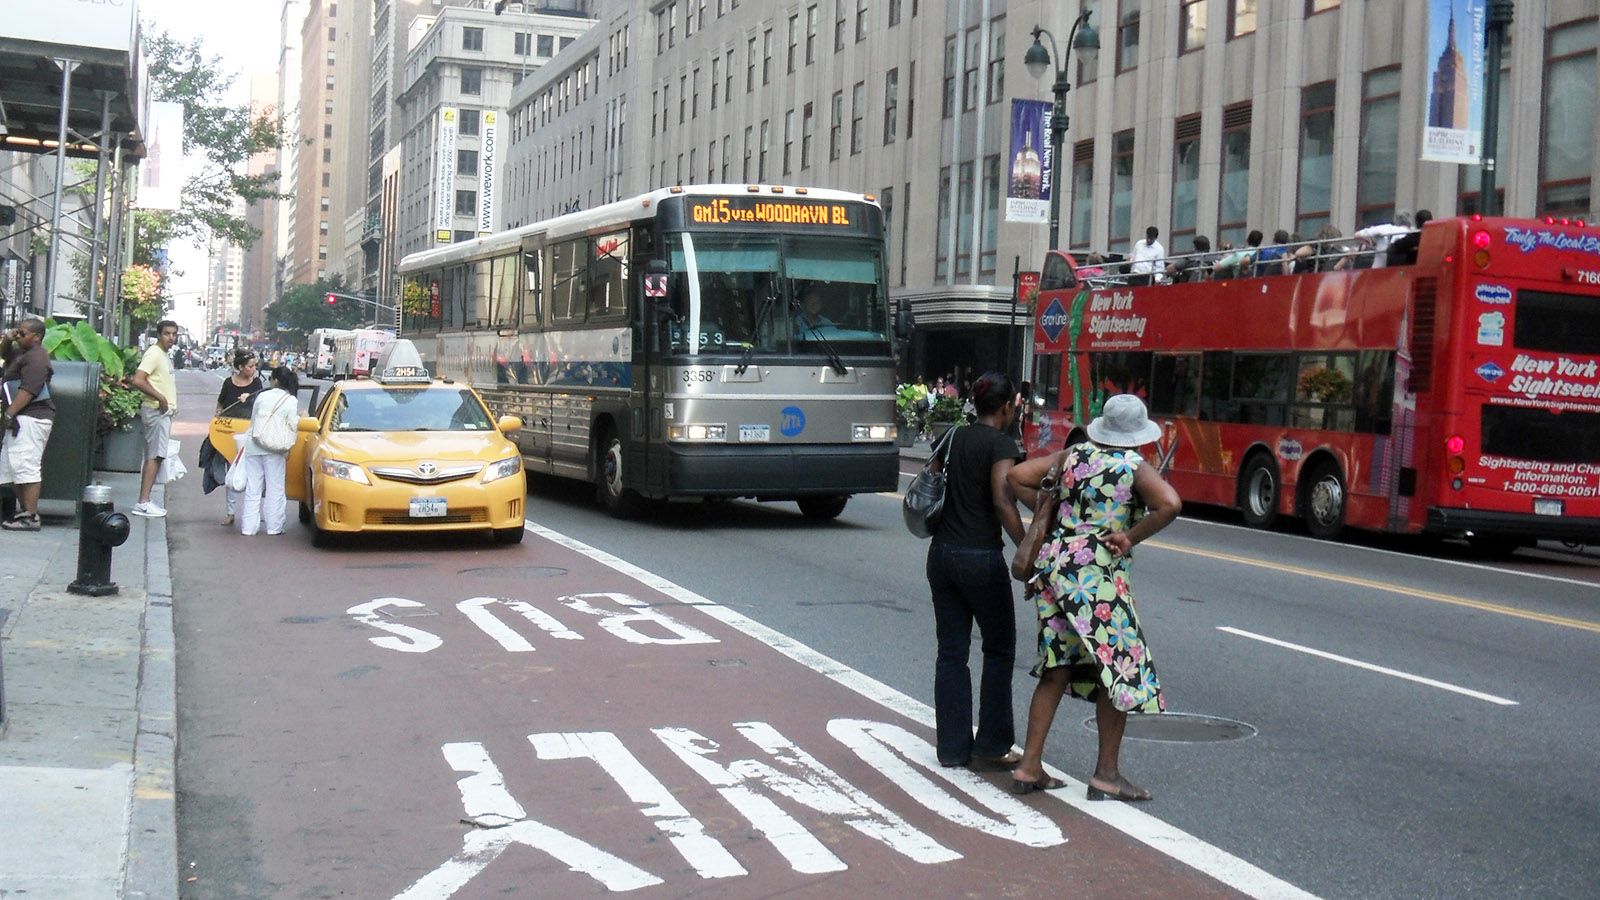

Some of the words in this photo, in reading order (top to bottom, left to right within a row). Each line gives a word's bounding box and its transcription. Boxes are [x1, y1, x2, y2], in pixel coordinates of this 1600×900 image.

[1044, 111, 1052, 127] The
[1043, 128, 1052, 148] Real
[1043, 148, 1052, 168] New
[482, 128, 494, 229] www.wework.com
[693, 199, 731, 223] QM15
[755, 203, 828, 224] WOODHAVN
[832, 206, 849, 225] BL
[1554, 232, 1585, 249] Local
[24, 271, 32, 303] bebe
[1090, 293, 1112, 311] New
[1112, 291, 1134, 310] York
[1088, 313, 1147, 339] Sightseeing
[396, 367, 416, 377] 2H54
[682, 370, 713, 382] 3358
[1510, 354, 1554, 373] New
[1556, 357, 1598, 378] York
[1508, 374, 1600, 399] Sightseei
[1478, 456, 1551, 473] Sightseeing
[1552, 463, 1576, 473] and
[1514, 470, 1587, 484] Information:
[1503, 481, 1597, 497] 1-800-669-0051
[346, 592, 720, 652] BUS
[391, 717, 1067, 900] ONLY
